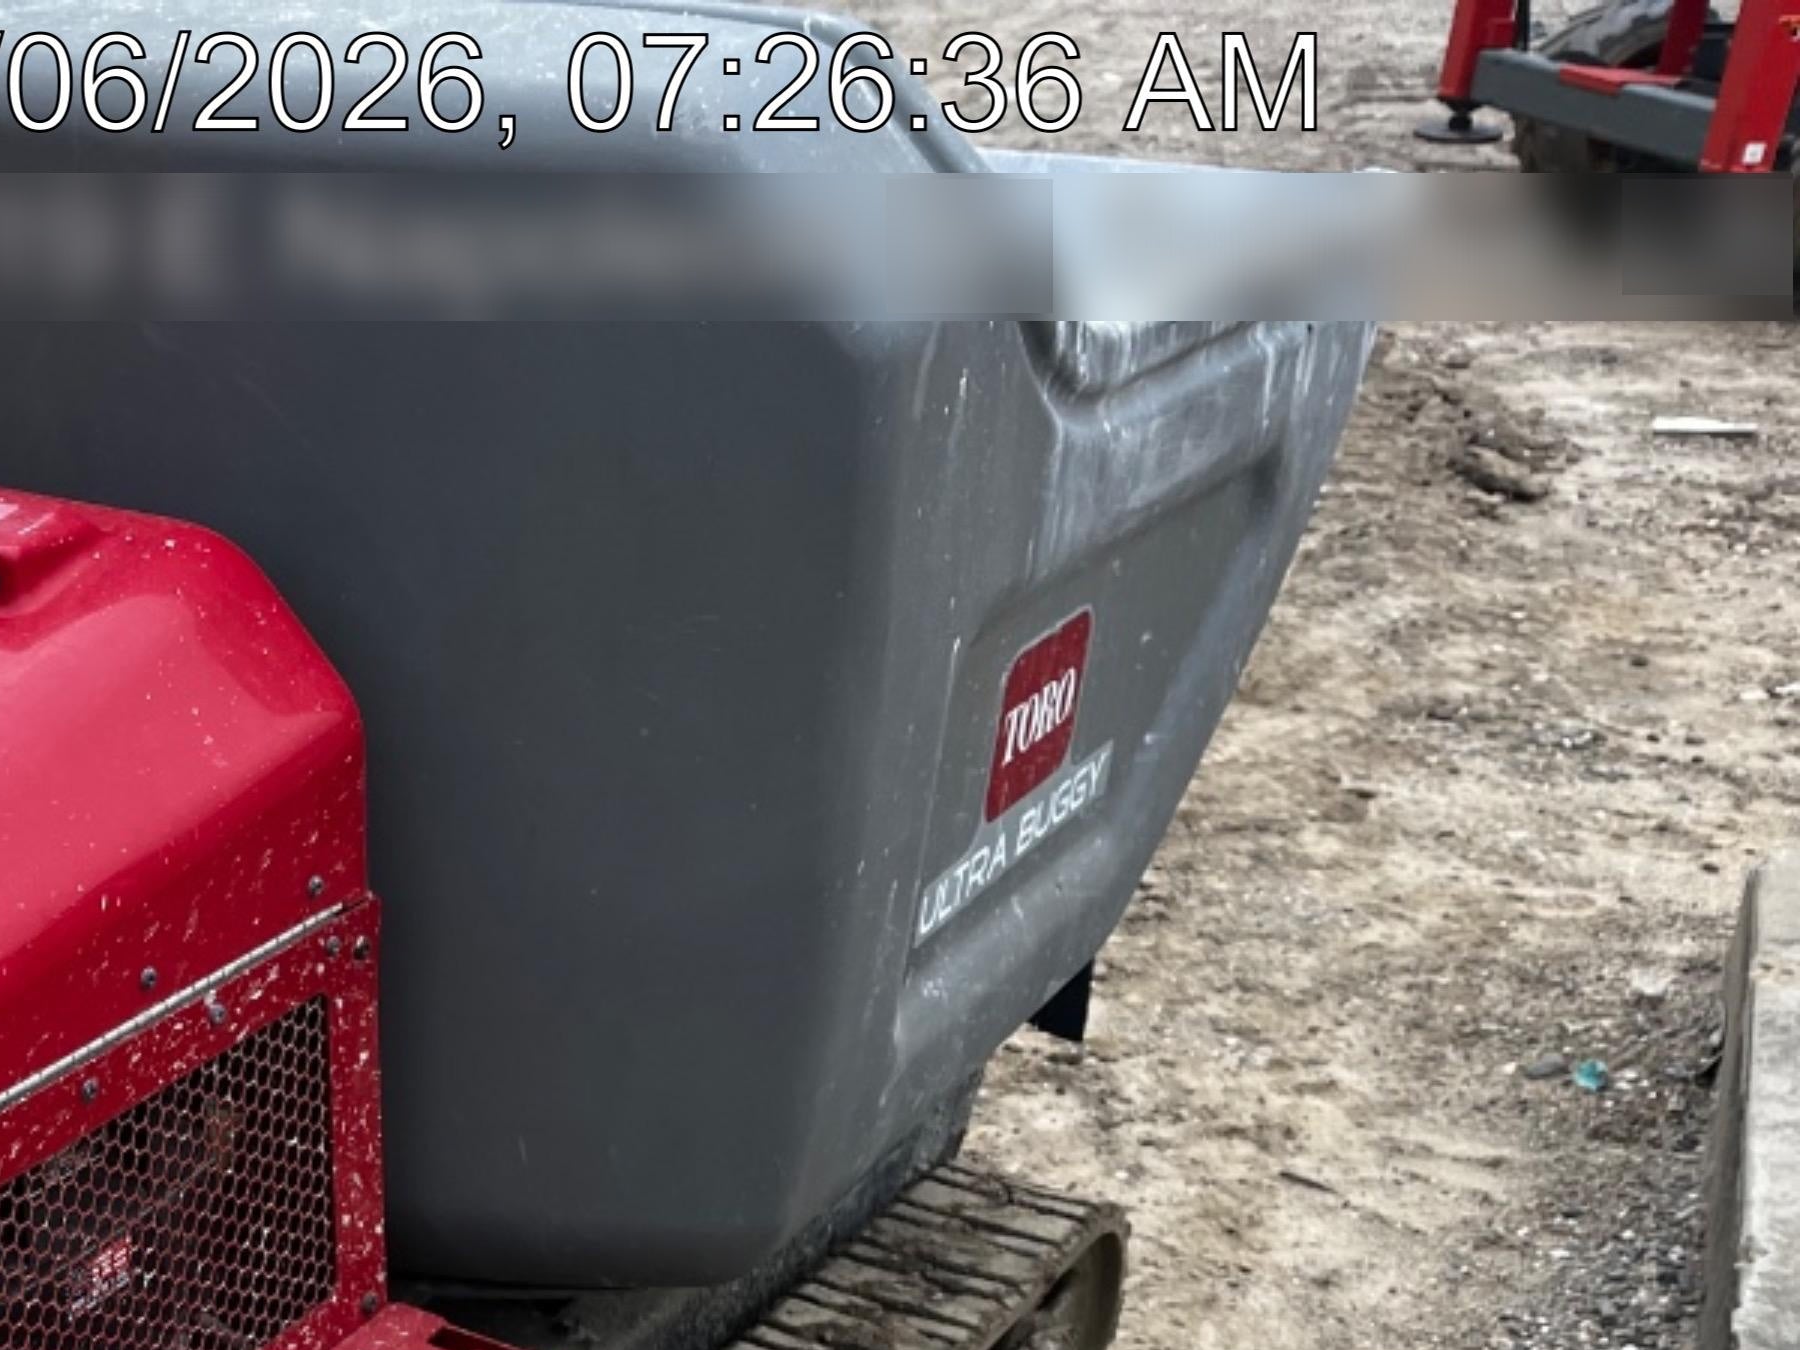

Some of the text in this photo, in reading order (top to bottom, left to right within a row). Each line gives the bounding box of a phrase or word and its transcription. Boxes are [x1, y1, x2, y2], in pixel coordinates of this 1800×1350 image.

[1003, 666, 1078, 767] TORO
[917, 750, 1110, 936] ULTRA BUGGY
